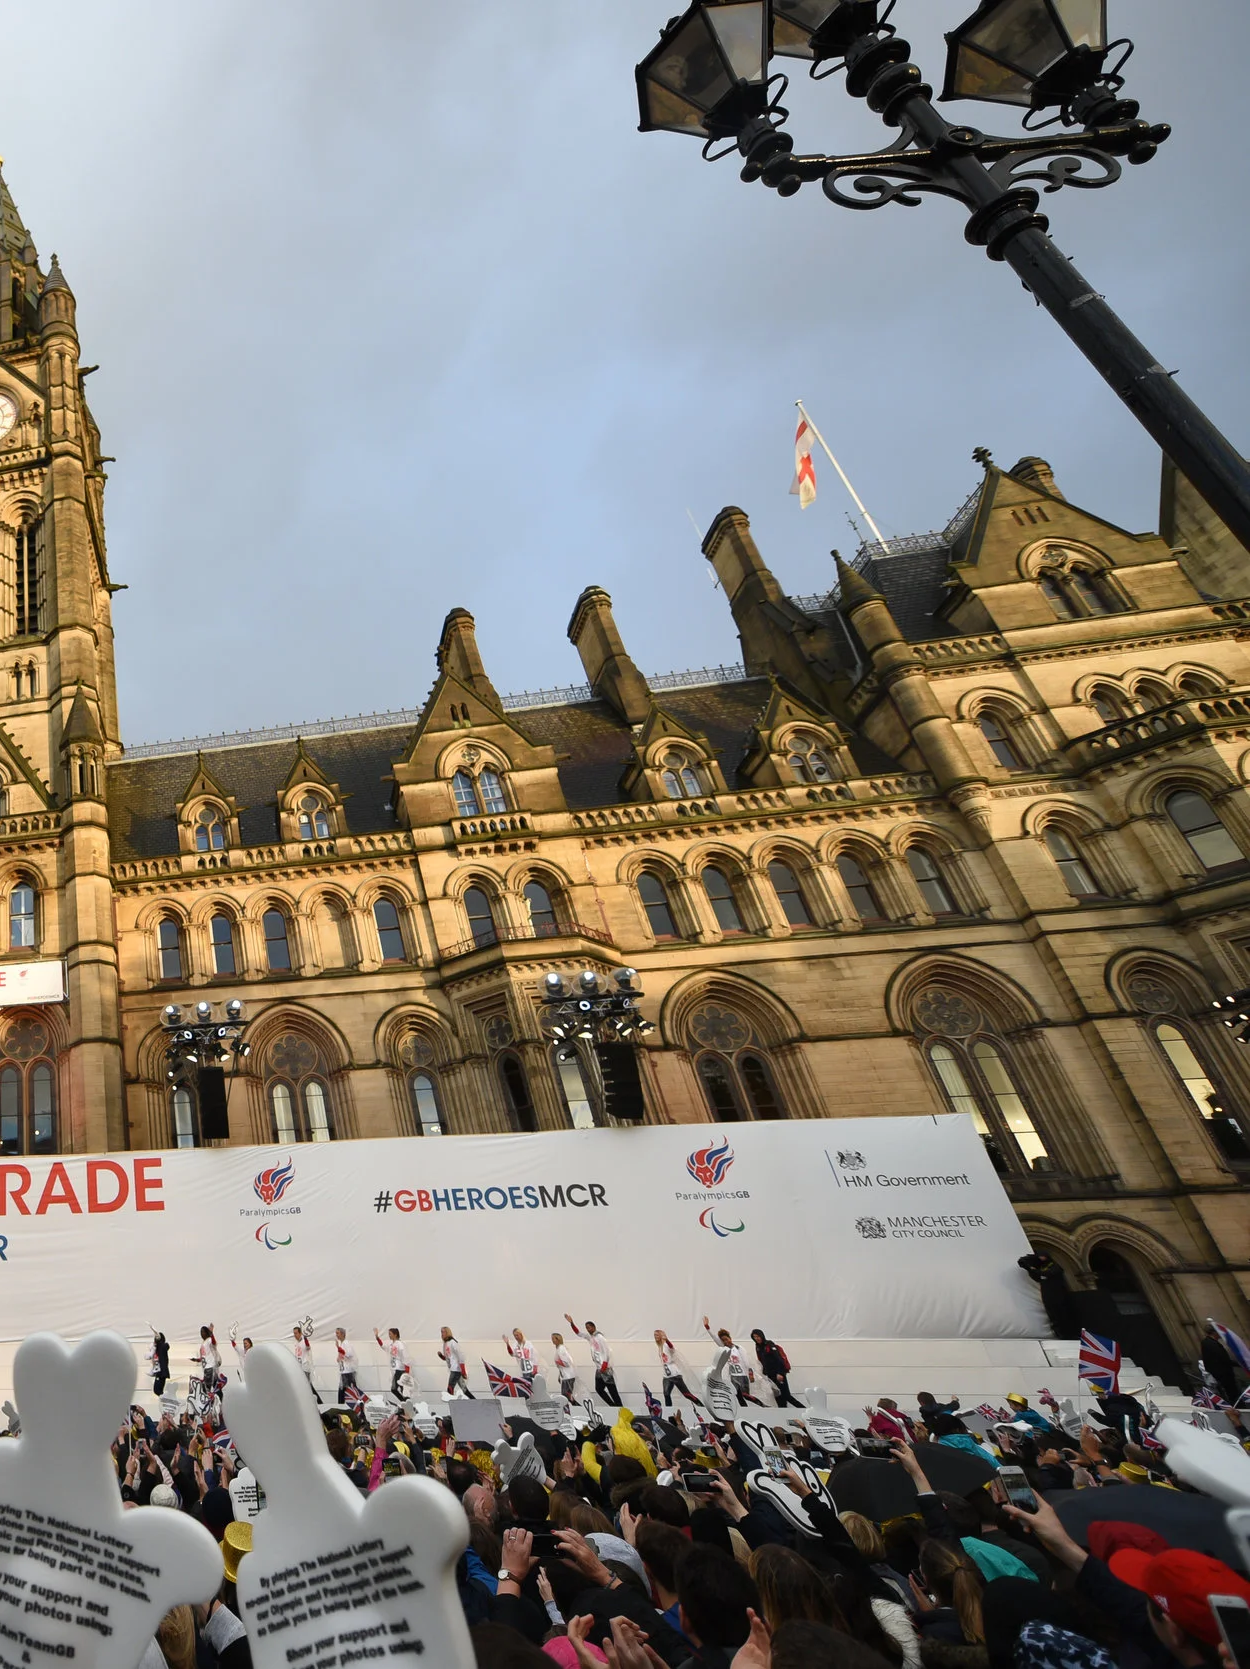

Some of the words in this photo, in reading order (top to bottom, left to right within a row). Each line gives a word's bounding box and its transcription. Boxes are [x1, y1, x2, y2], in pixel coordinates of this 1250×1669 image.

[675, 1190, 750, 1202] ParalympicsGB
[844, 1175, 873, 1189] HM
[877, 1172, 972, 1188] Government
[239, 1206, 302, 1218] ParalympicsGB
[374, 1183, 609, 1214] #GBHEROESMCR
[886, 1215, 988, 1229] MANCHESTER
[892, 1230, 916, 1239] CITY
[918, 1229, 965, 1239] COUNCIL
[25, 1509, 44, 1523] The
[47, 1516, 91, 1537] National
[94, 1530, 134, 1554] Lottery
[15, 1535, 35, 1546] and
[36, 1537, 94, 1566] Paralympic
[97, 1561, 145, 1588] athletes,
[26, 1525, 53, 1539] more
[56, 1533, 79, 1547] than
[81, 1542, 101, 1555] you
[104, 1548, 115, 1560] to
[118, 1555, 160, 1578] support
[13, 1545, 26, 1556] for
[27, 1547, 57, 1569] being
[59, 1561, 83, 1576] part
[85, 1570, 97, 1581] of
[99, 1575, 117, 1589] the
[120, 1582, 152, 1603] team.
[3, 1573, 27, 1590] your
[30, 1584, 82, 1608] support
[85, 1600, 109, 1618] and
[24, 1601, 72, 1623] photos
[76, 1615, 113, 1638] using:
[21, 1650, 31, 1664] &
